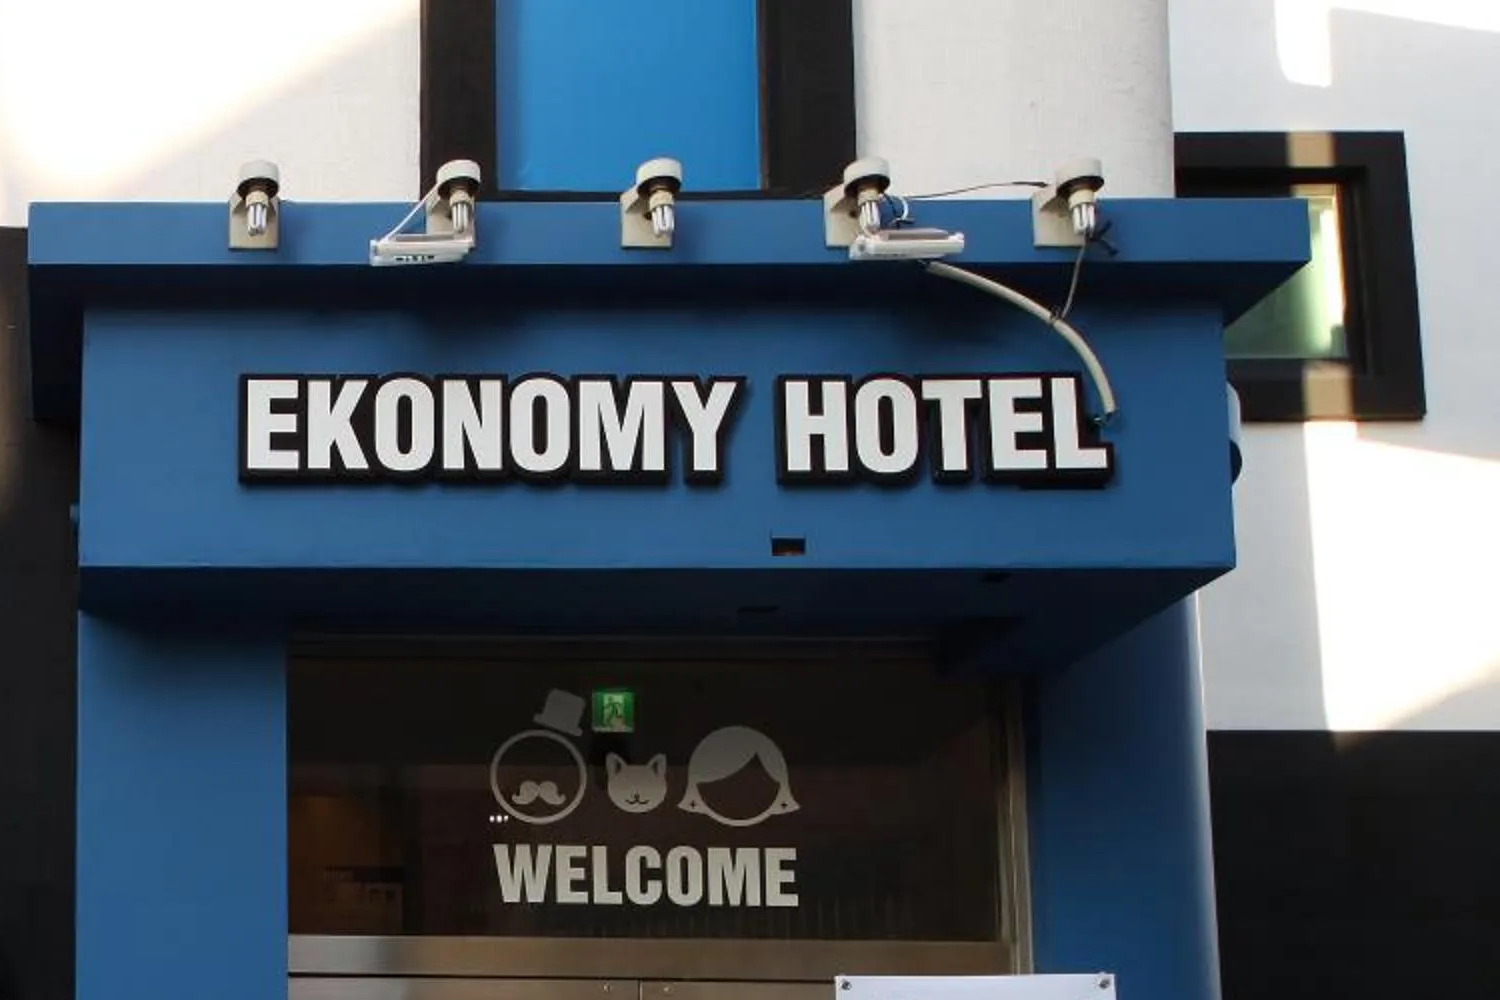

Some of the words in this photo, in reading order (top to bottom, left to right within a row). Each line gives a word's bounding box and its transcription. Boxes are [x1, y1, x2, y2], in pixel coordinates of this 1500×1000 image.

[245, 378, 736, 473] EKONOMY
[785, 377, 1109, 473] HOTEL
[492, 843, 800, 907] WELCOME
